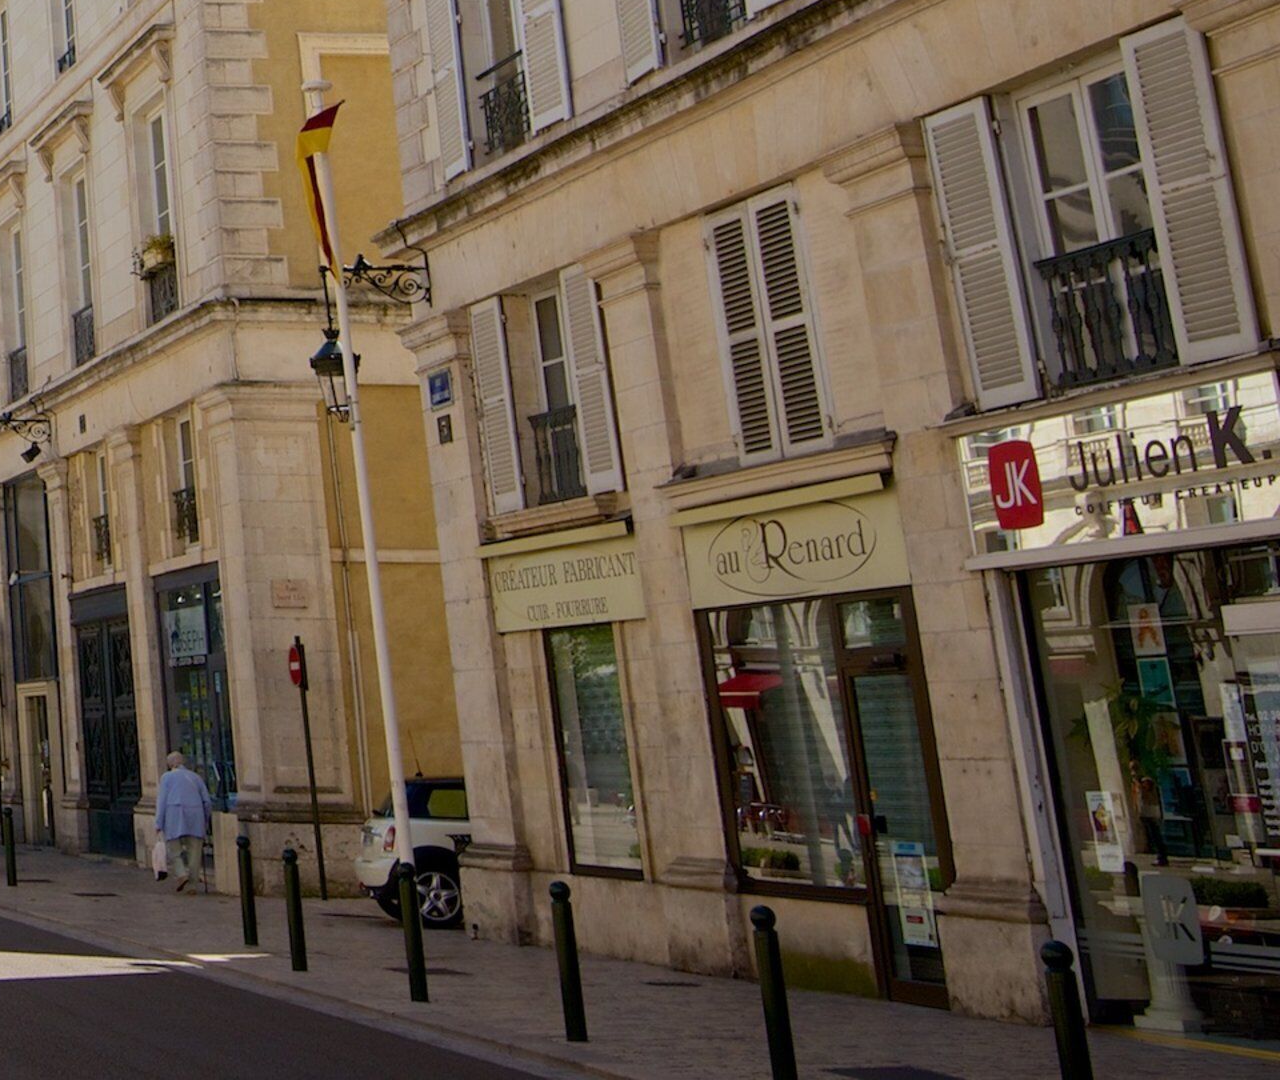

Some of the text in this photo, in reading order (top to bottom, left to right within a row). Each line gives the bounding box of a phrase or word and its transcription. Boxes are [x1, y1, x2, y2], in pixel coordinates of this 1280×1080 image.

[1069, 406, 1272, 492] Julien K.
[996, 459, 1037, 509] JK
[495, 552, 635, 593] CRÉATEUR FABRICANT
[716, 519, 867, 576] au Renard
[527, 604, 550, 621] CUIR
[556, 597, 609, 619] FOURRURE
